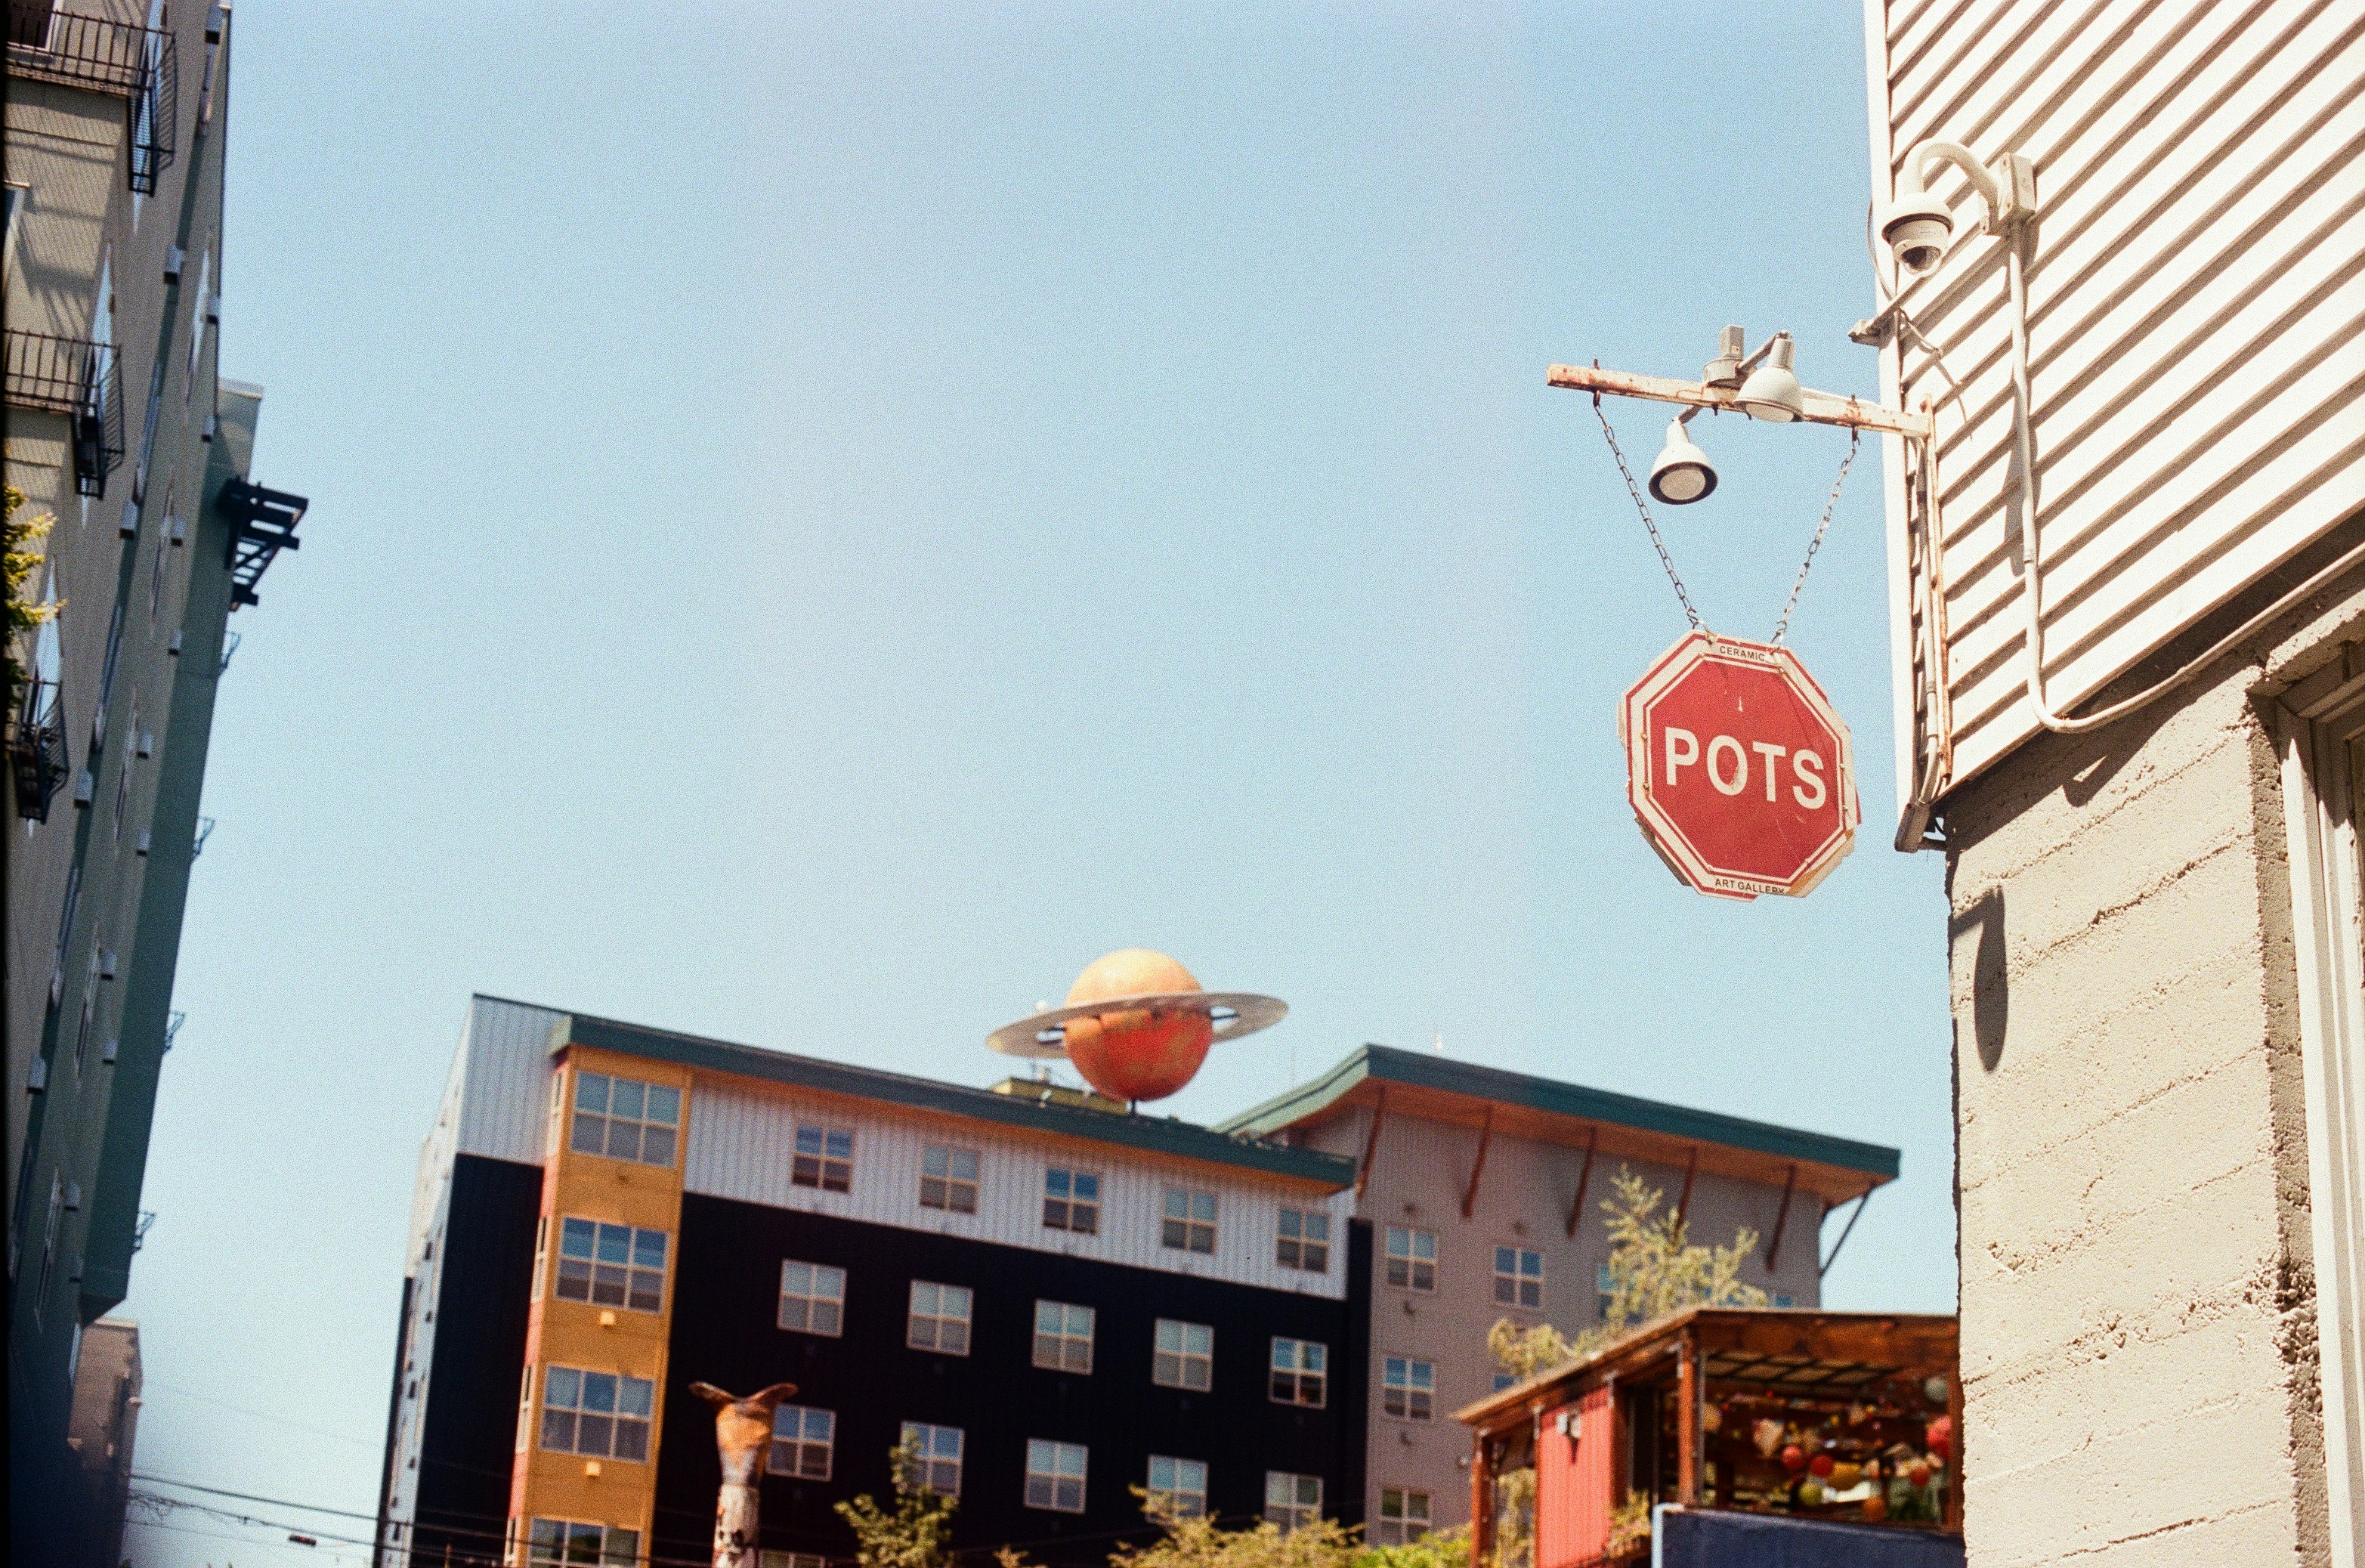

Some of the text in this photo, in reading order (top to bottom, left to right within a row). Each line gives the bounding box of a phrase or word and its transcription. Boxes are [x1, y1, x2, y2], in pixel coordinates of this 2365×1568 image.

[1720, 645, 1765, 661] CERAMIC
[1665, 726, 1826, 809] POTS
[1715, 878, 1784, 893] ART GALLERY
